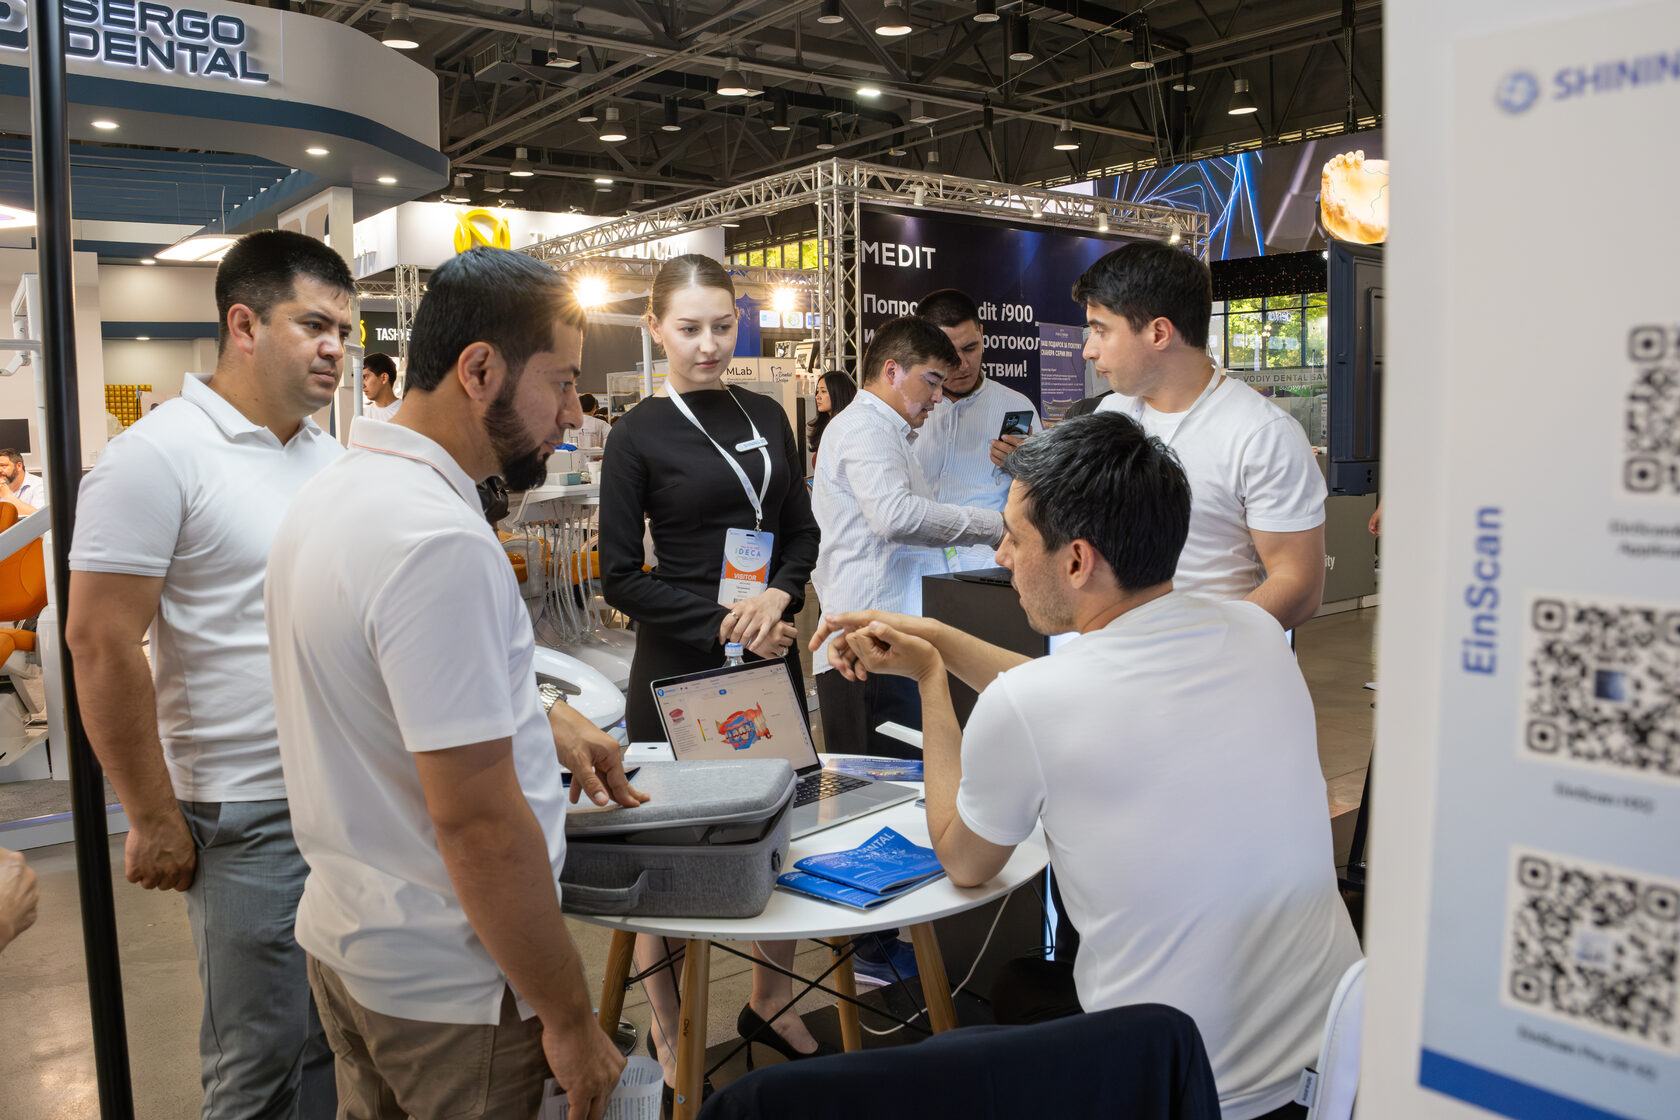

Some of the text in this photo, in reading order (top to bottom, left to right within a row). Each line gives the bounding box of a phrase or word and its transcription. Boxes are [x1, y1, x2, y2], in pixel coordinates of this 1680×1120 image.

[64, 0, 245, 46] SERGO
[65, 24, 270, 83] DENTAL
[1553, 50, 1680, 101] SHININ
[861, 240, 936, 269] MEDIT
[863, 293, 918, 318] Попро
[978, 301, 1033, 323] dit i900
[376, 328, 412, 341] TASHE
[982, 334, 1040, 353] ротокол
[981, 360, 1027, 378] ствии!
[1243, 374, 1271, 383] VODIY
[1273, 374, 1307, 382] DENTAL
[1324, 554, 1335, 570] ity
[1462, 506, 1502, 676] EinScan
